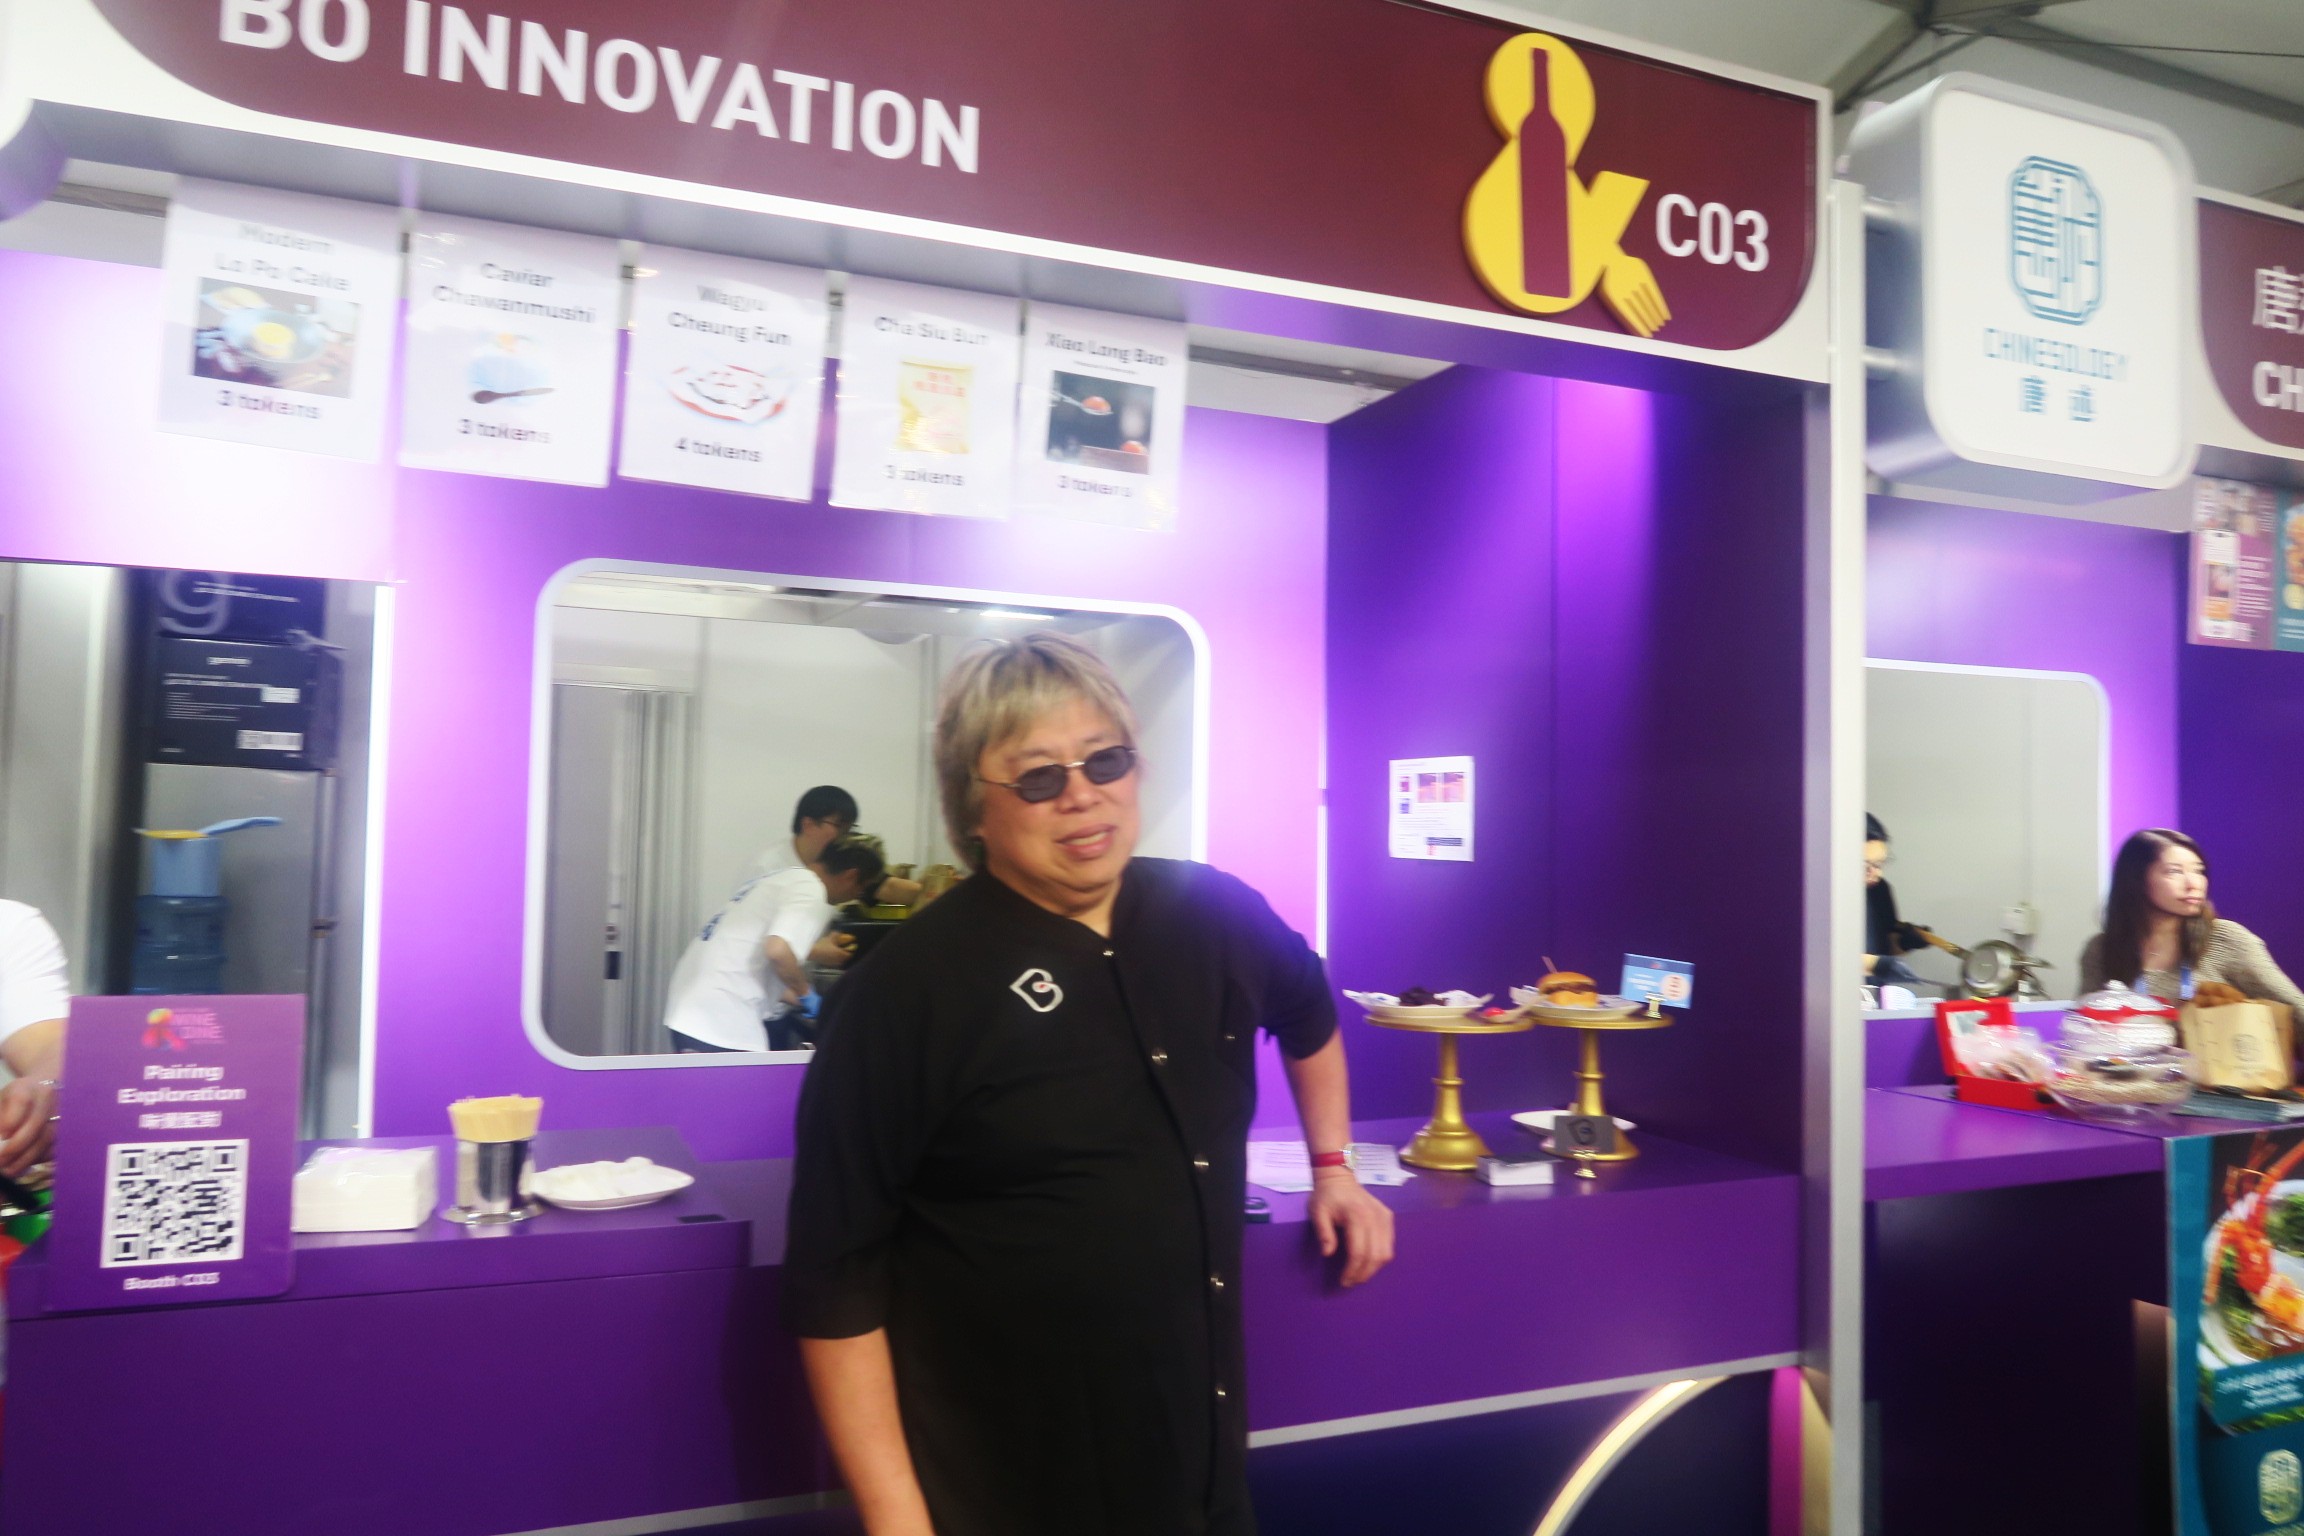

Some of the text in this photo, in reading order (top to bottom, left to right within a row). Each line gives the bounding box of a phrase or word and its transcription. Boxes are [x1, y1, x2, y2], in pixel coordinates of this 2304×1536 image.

[220, 0, 980, 173] BO INNOVATION
[1655, 193, 1770, 272] C03
[117, 1086, 247, 1105] Exploration
[143, 1064, 224, 1081] Pairing
